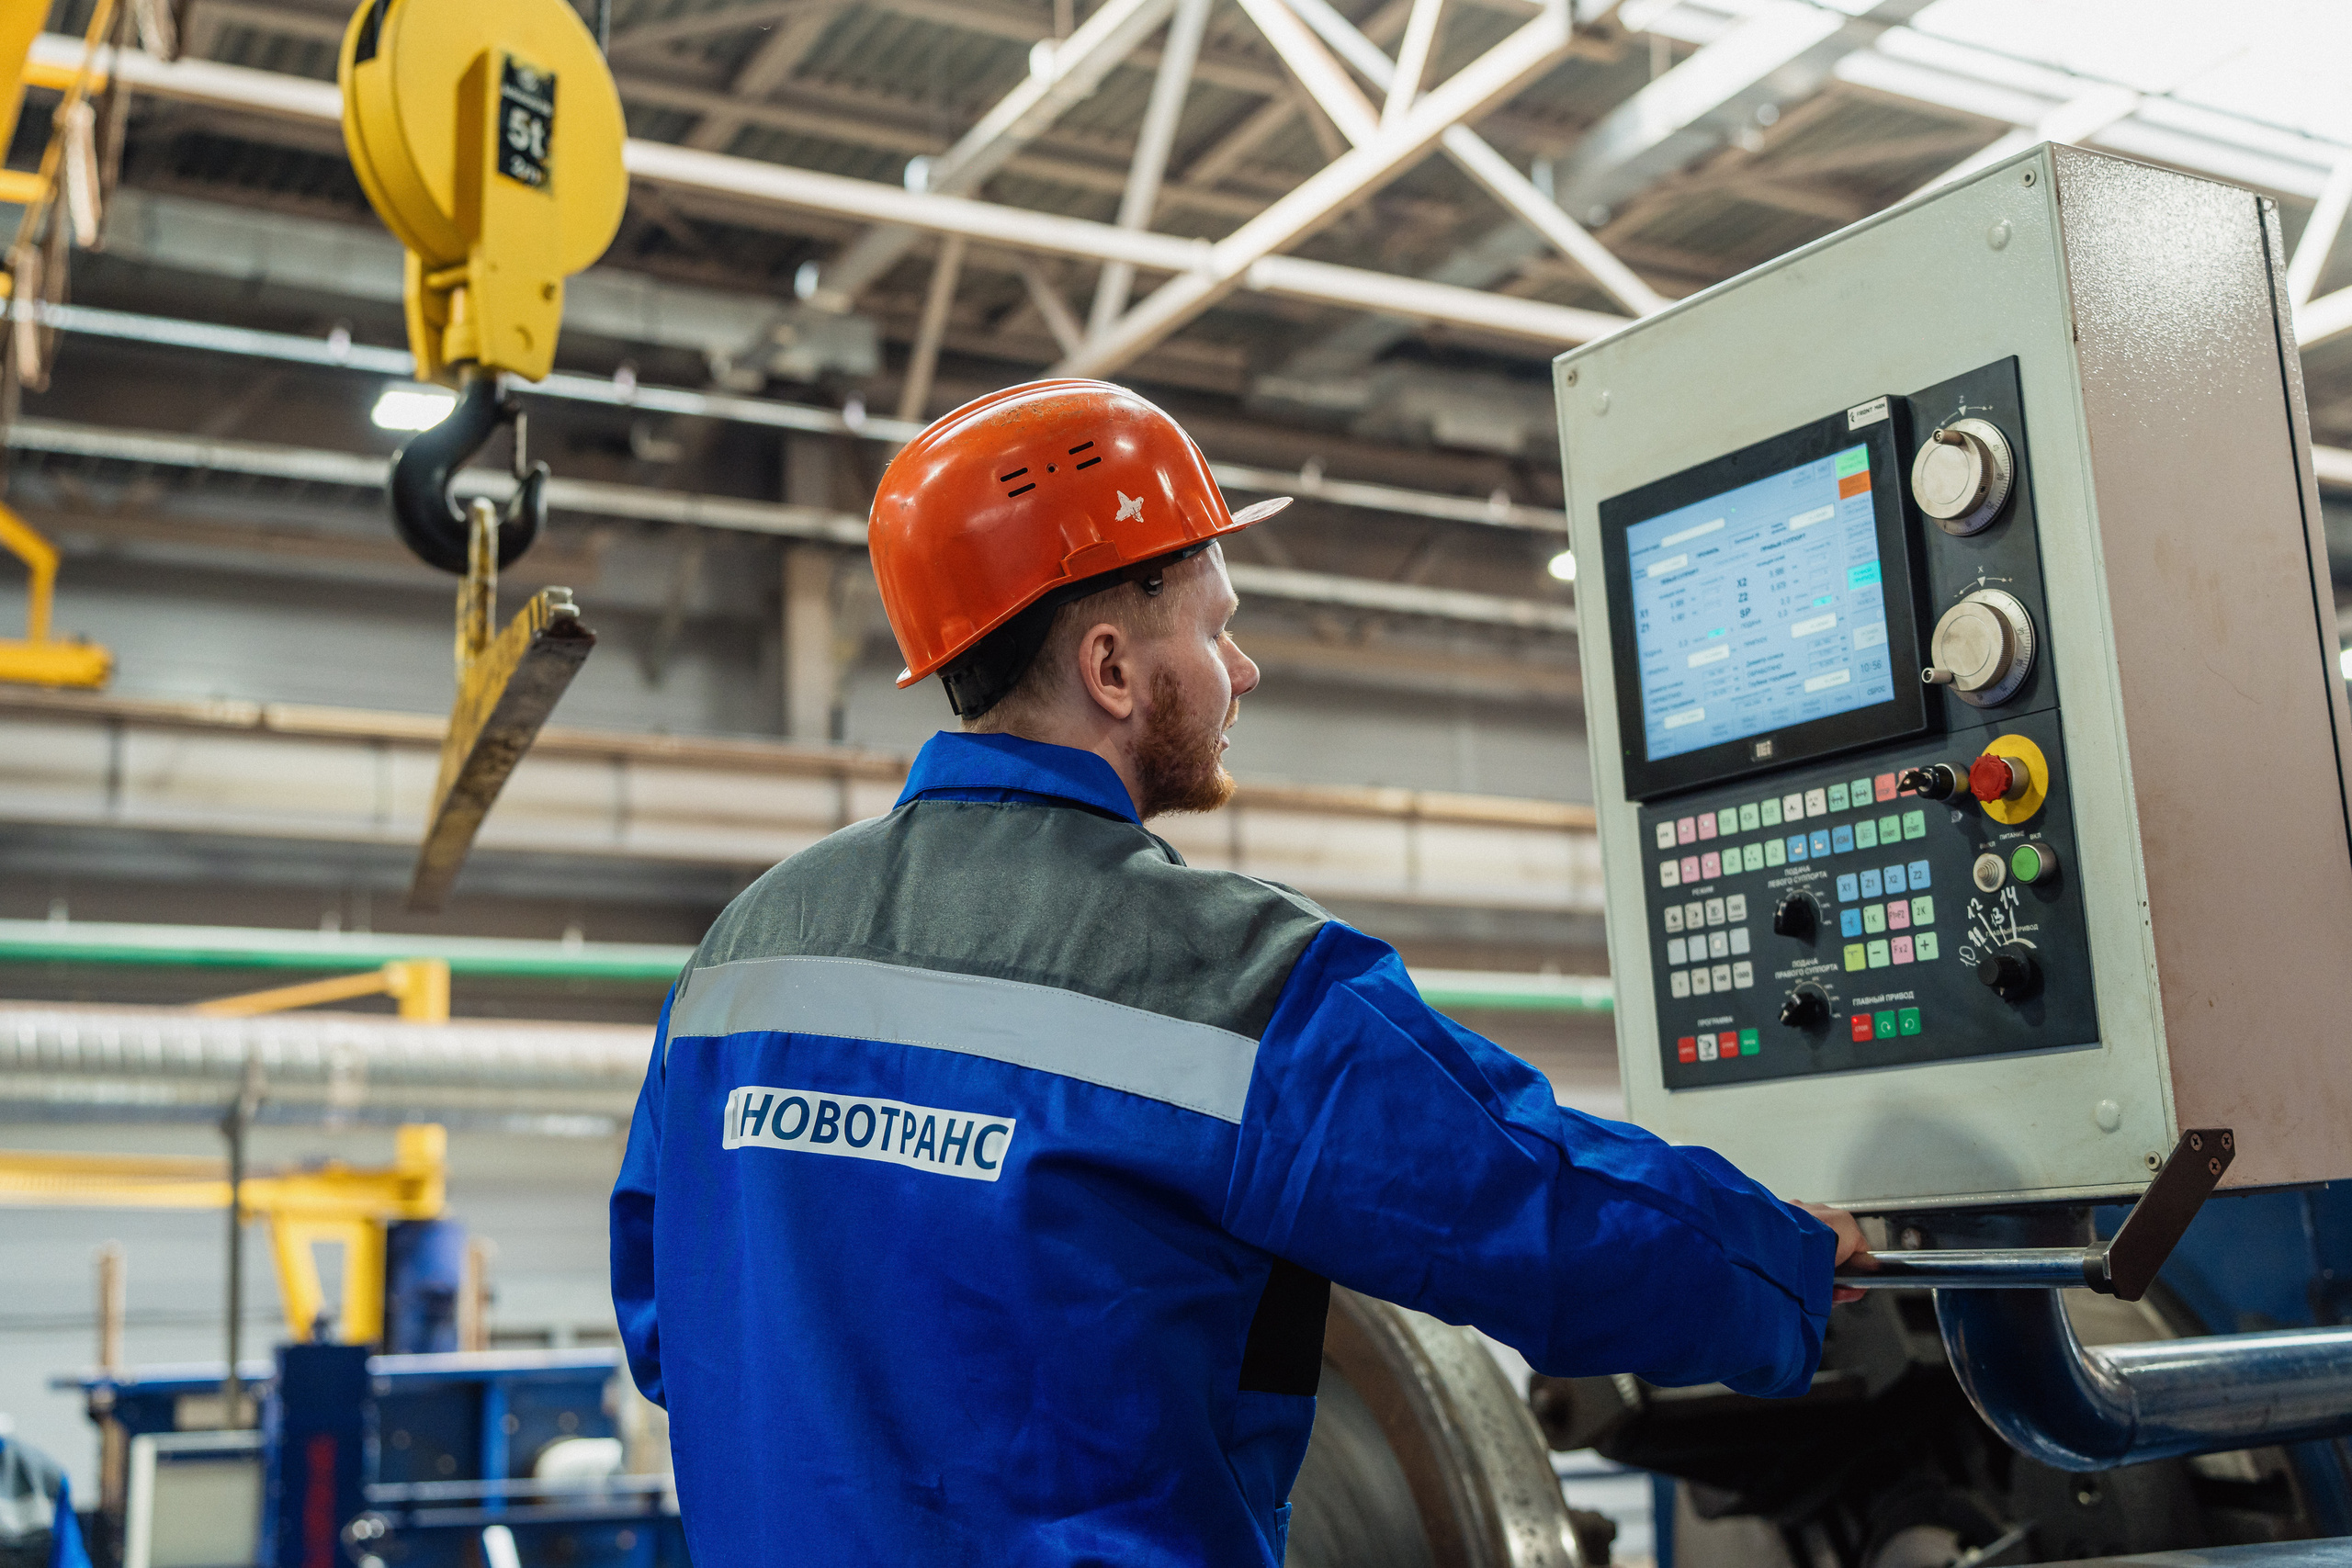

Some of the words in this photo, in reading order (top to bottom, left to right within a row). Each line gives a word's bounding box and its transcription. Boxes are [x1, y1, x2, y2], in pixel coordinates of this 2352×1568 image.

[506, 106, 547, 160] 5t
[1959, 395, 1965, 403] Z
[1977, 565, 1984, 574] X
[1736, 578, 1747, 588] X2
[1738, 592, 1748, 603] Z2
[1739, 607, 1751, 619] SP
[1860, 659, 1883, 673] 10:56
[1998, 829, 2025, 840] ПИТАНИЕ
[2029, 831, 2041, 840] ВКЛ
[1783, 864, 1812, 876] ПОДАЧА
[1913, 870, 1922, 880] Z2
[1864, 878, 1874, 888] Z1
[1888, 874, 1898, 885] X2
[1841, 883, 1851, 892] X1
[1999, 886, 2019, 910] 14
[1966, 897, 1984, 919] 12
[1991, 907, 2005, 927] 13
[1958, 945, 1976, 966] 10
[1792, 957, 1818, 968] ПОДАЧА
[1774, 968, 1804, 980] ПРАВОГО
[1804, 963, 1838, 976] СУППОРТА
[1852, 994, 1884, 1007] ГЛАВНЫЙ
[1885, 990, 1915, 1002] ПРИВОД
[740, 1092, 1010, 1170] НОВОТРАНС
